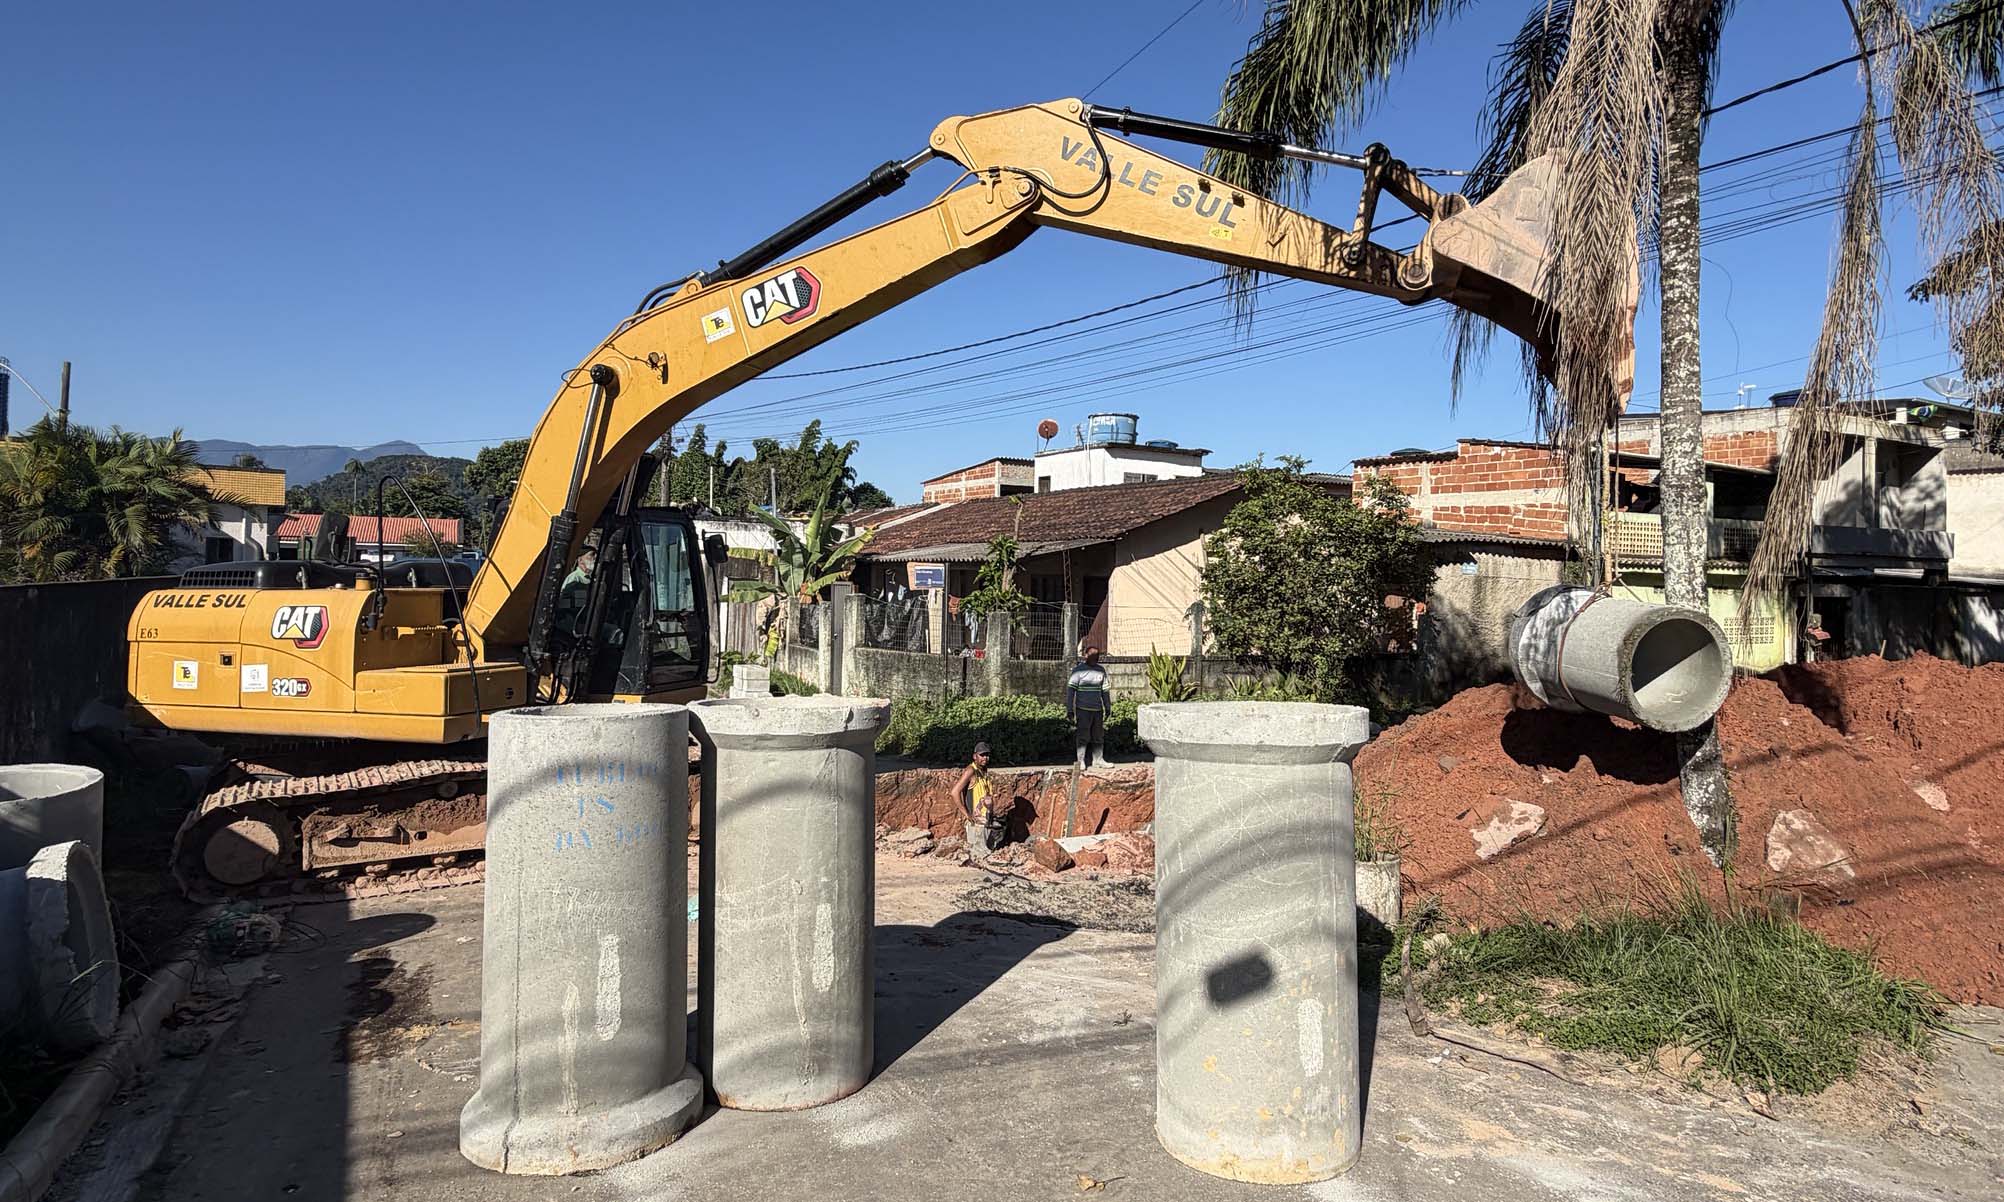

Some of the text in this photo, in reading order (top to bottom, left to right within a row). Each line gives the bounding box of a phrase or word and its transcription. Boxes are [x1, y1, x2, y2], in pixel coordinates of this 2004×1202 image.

[1172, 184, 1237, 229] SUL
[742, 269, 801, 327] CAT
[153, 593, 246, 608] VALLE SUL
[140, 628, 159, 639] E63
[271, 606, 321, 639] CAT
[272, 678, 298, 697] 320
